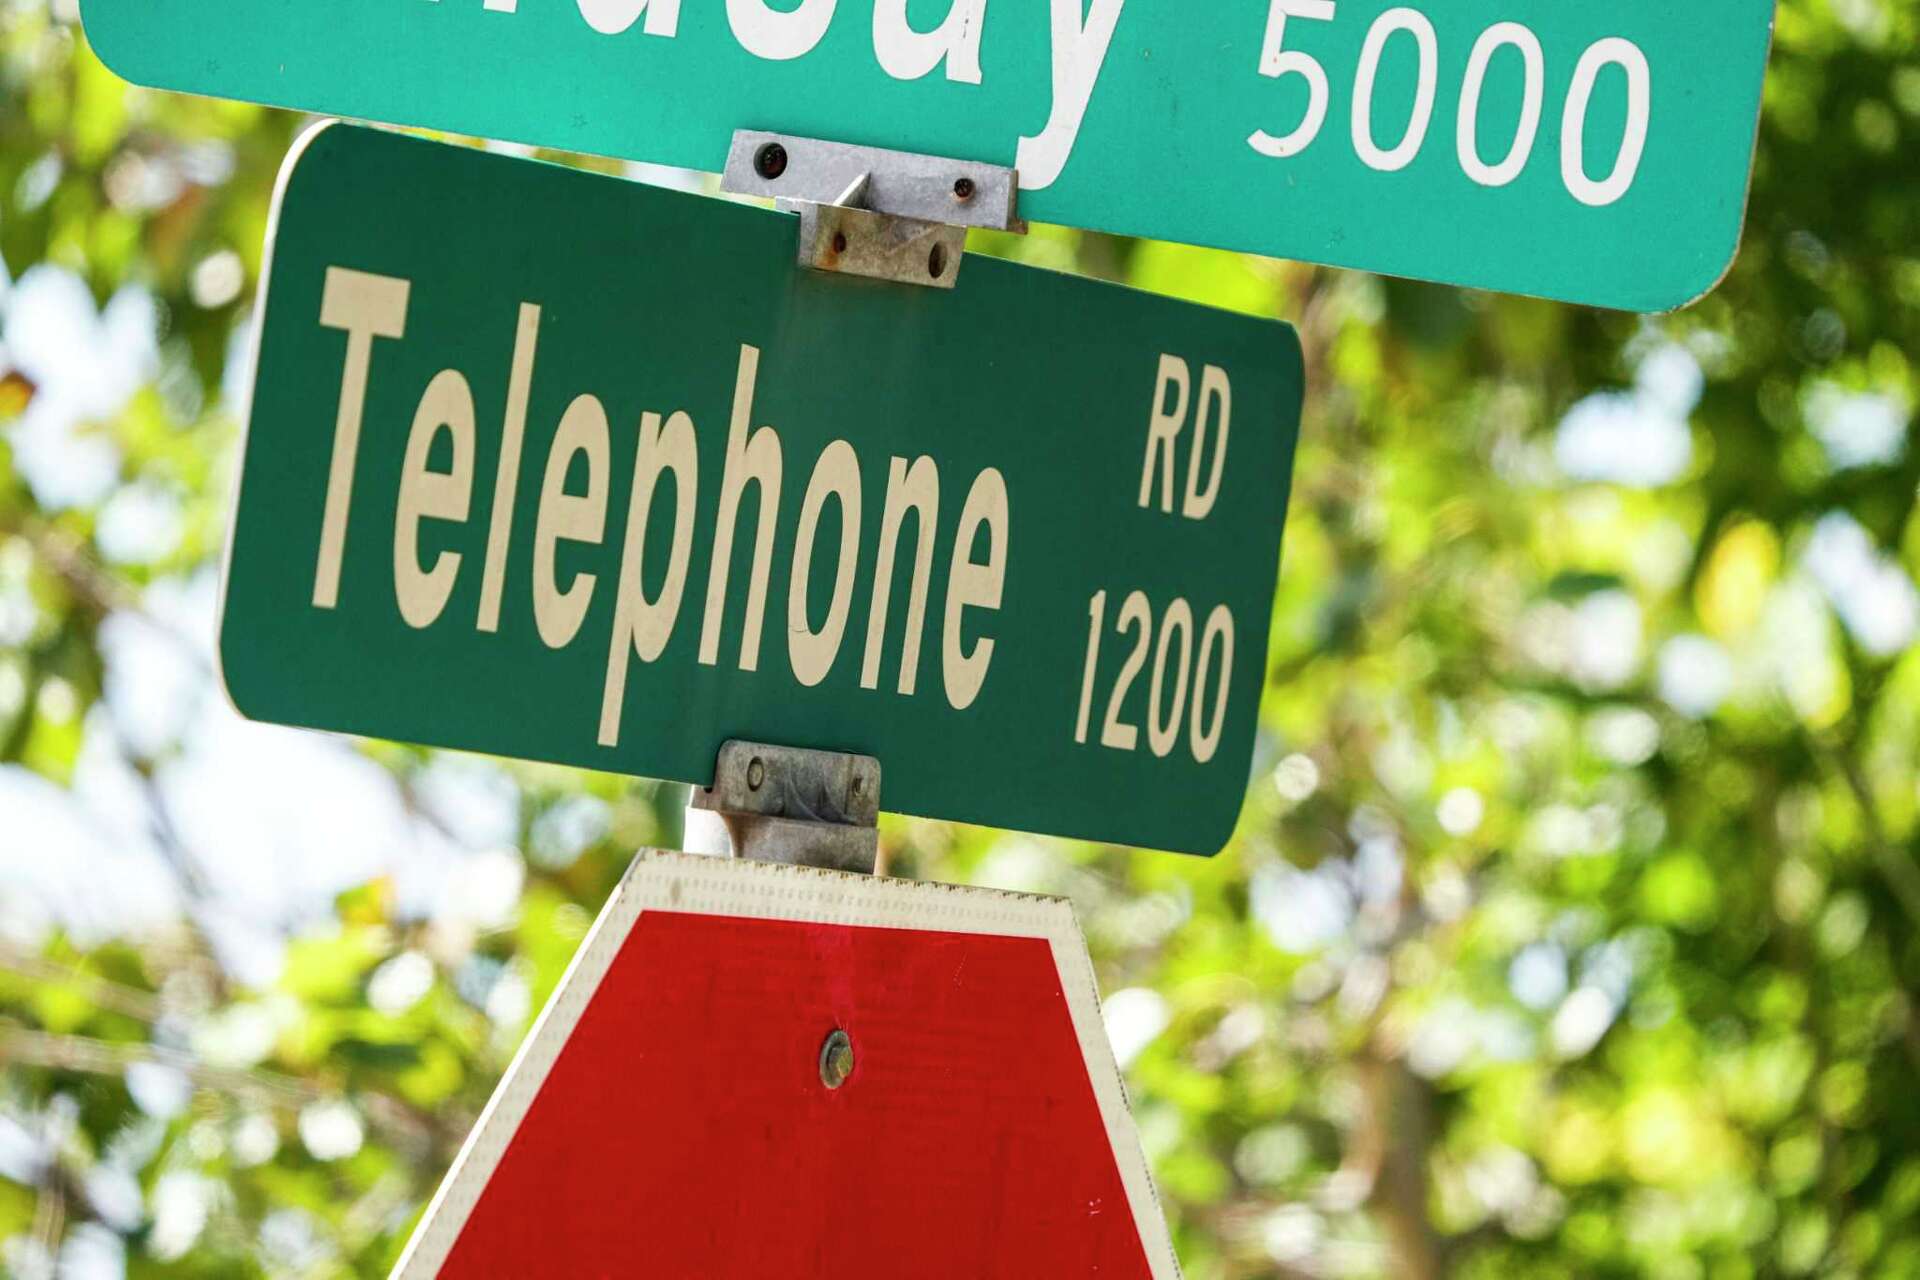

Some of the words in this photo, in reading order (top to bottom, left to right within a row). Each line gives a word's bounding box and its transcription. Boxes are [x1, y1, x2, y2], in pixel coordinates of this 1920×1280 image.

[1247, 0, 1650, 206] 5000
[313, 267, 1009, 747] Telephone
[1139, 353, 1231, 519] RD
[1075, 590, 1234, 763] 1200
